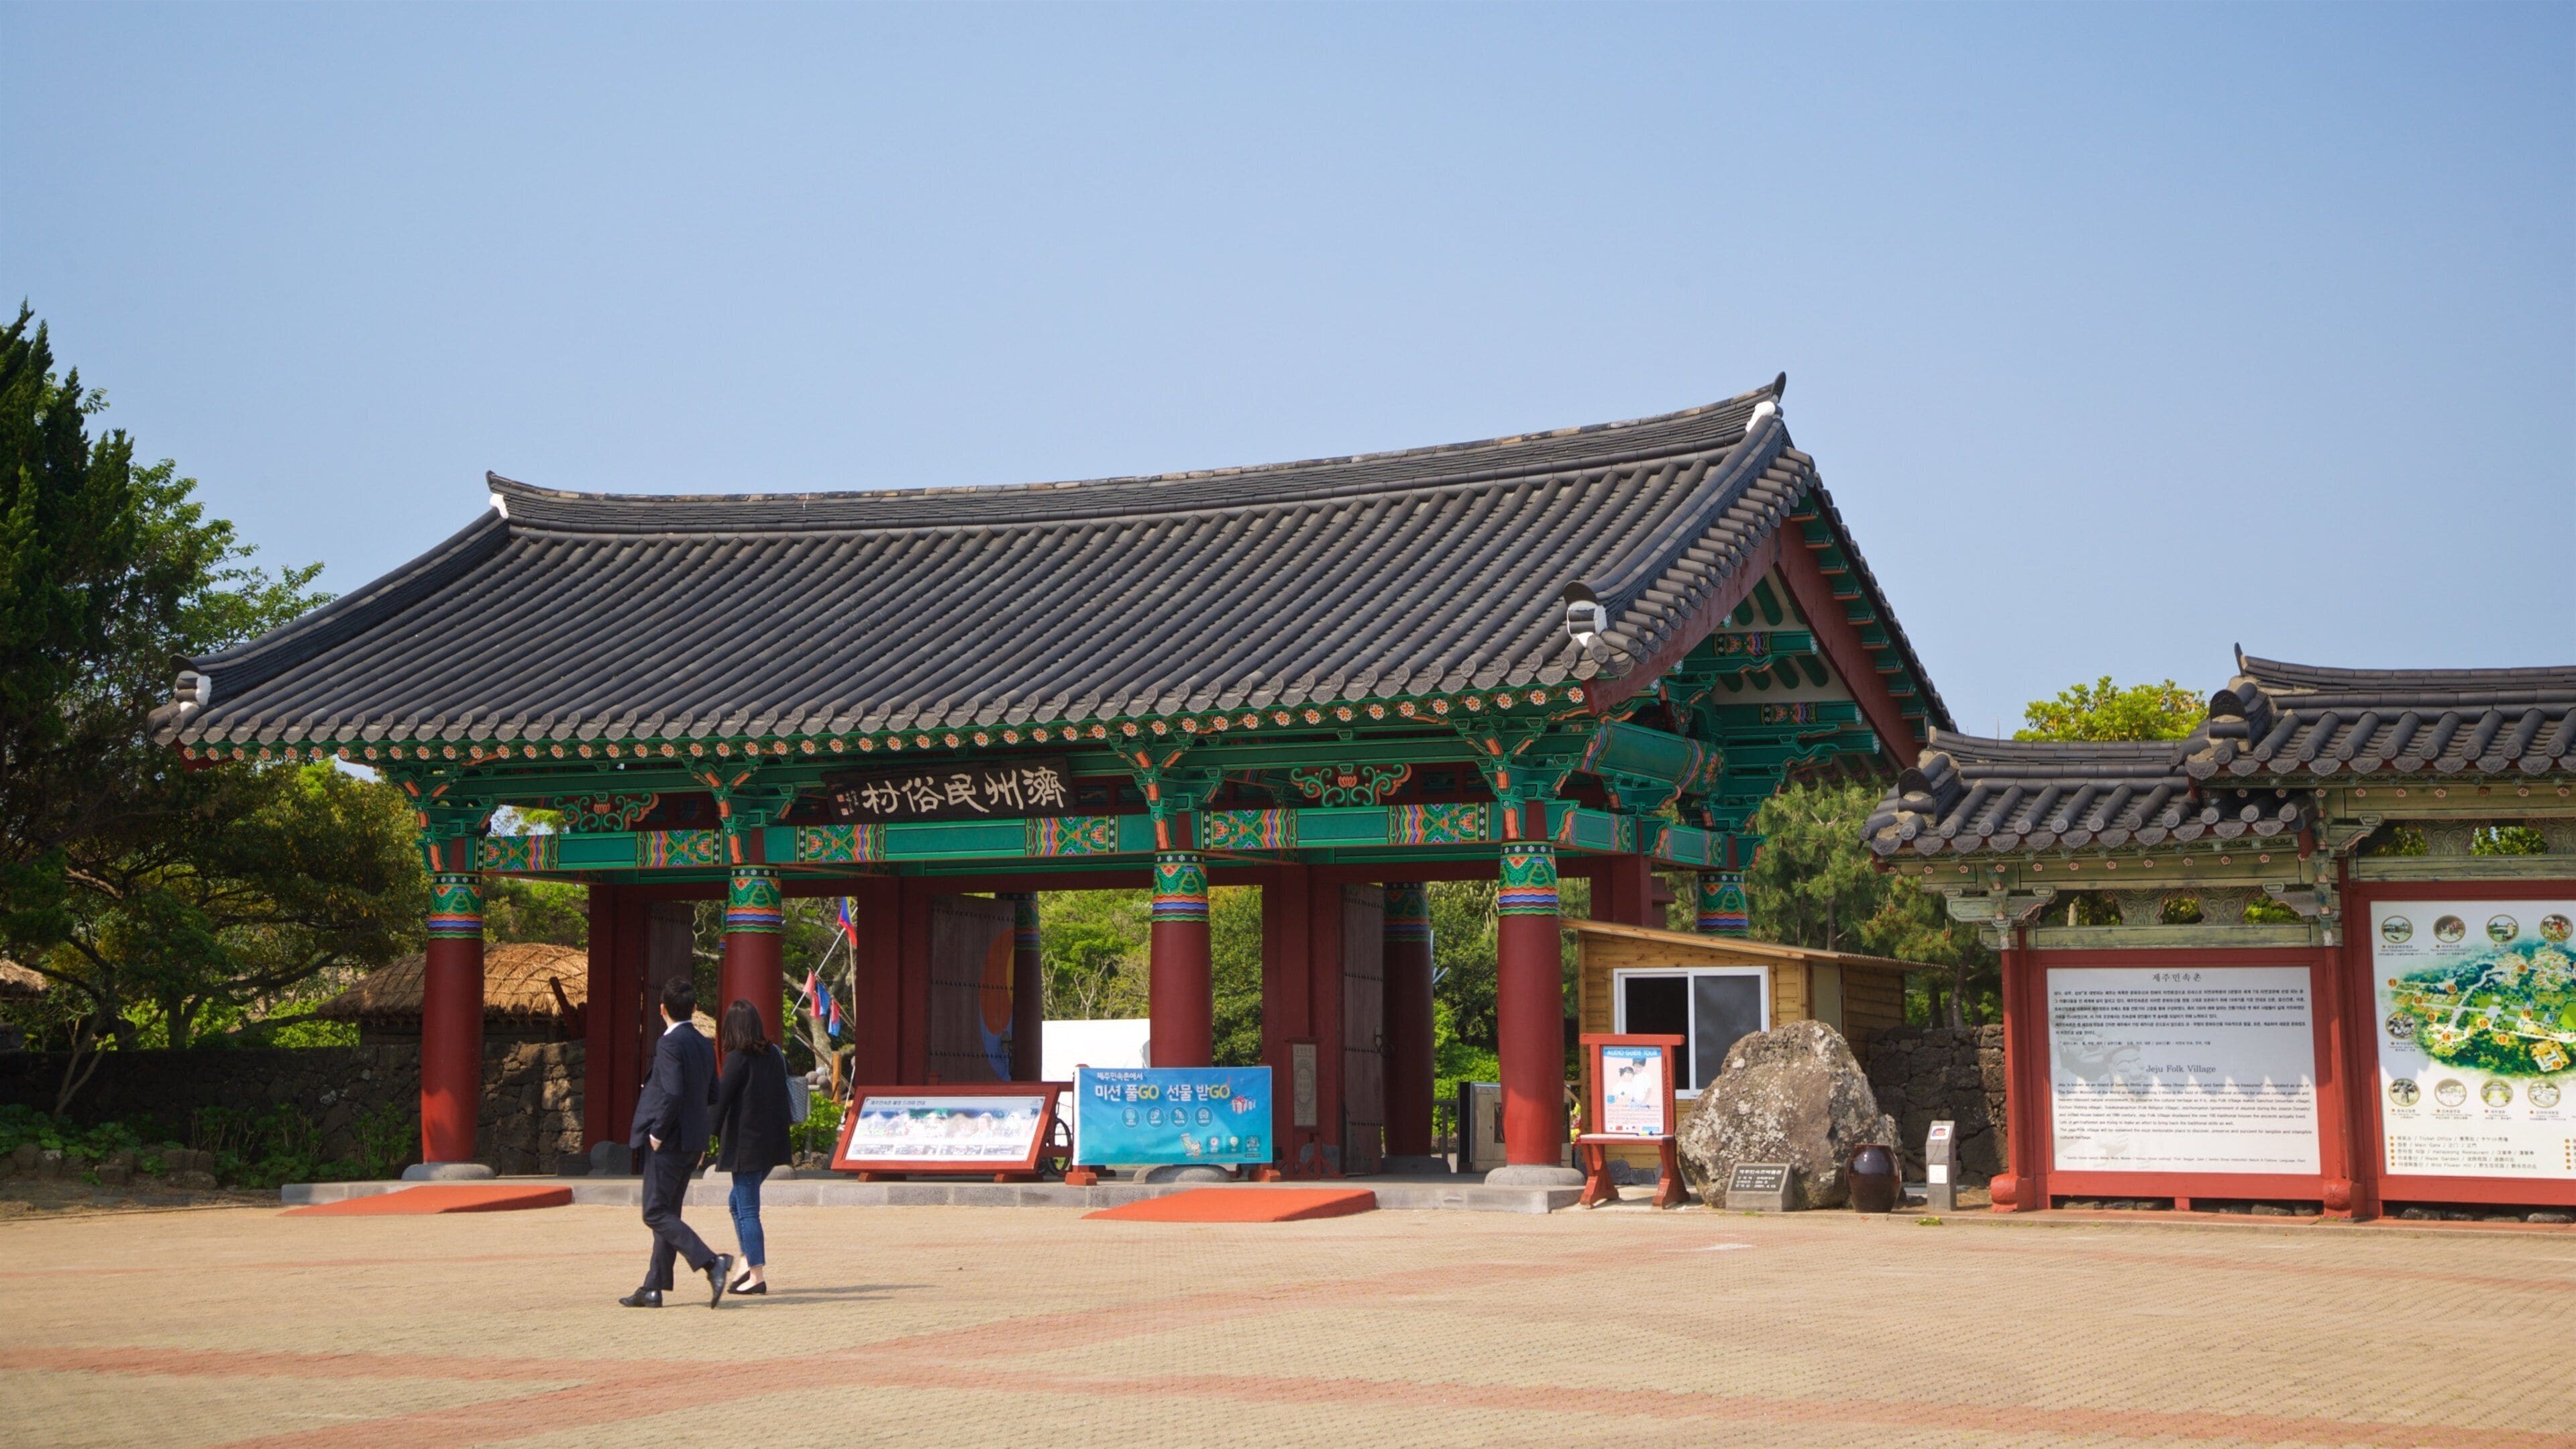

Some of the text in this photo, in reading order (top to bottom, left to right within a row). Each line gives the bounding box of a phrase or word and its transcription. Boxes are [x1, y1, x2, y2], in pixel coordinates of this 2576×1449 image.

[2152, 973, 2202, 982] 제주민속촌
[2146, 1065, 2216, 1074] Jeju Folk Village
[1097, 1072, 1143, 1081] 제주민속촌에서
[1095, 1084, 1230, 1101] 미션 풀GO 선물 받GO
